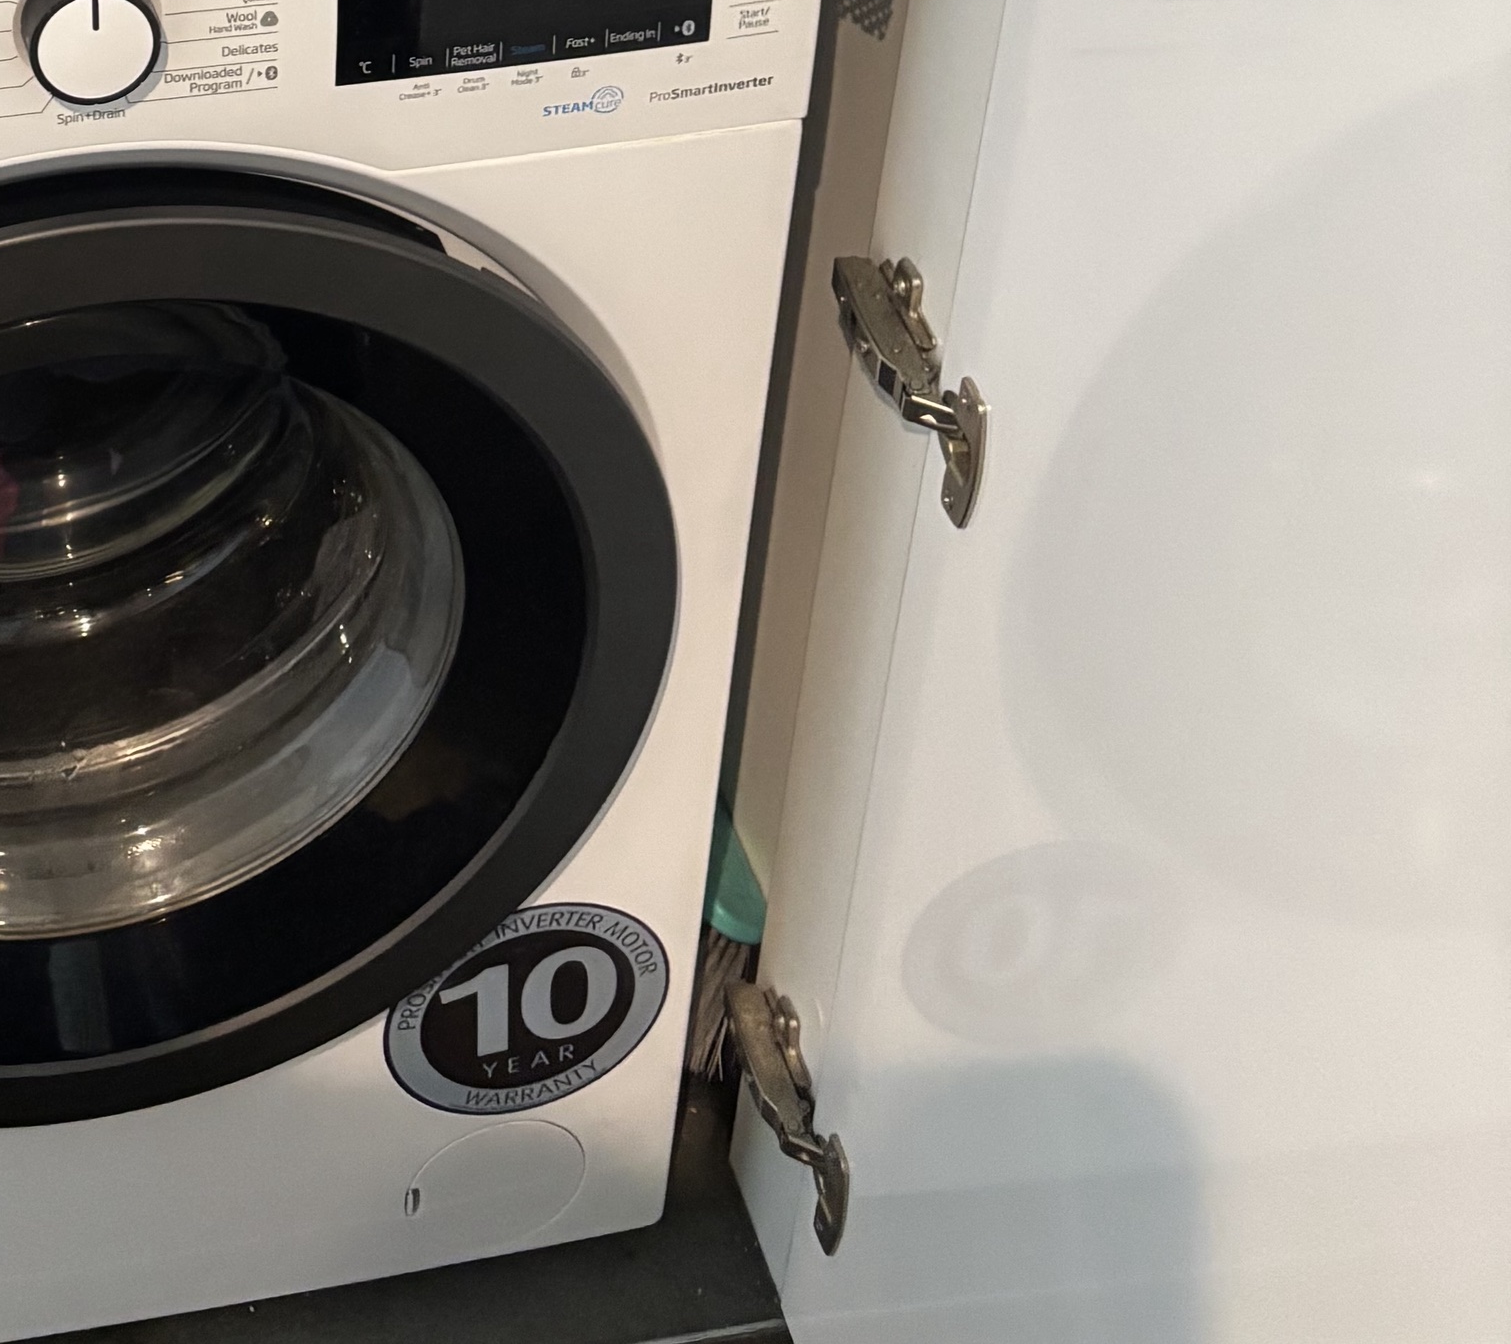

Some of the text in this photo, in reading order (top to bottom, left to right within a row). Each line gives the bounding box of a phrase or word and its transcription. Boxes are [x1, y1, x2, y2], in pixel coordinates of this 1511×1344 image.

[226, 10, 257, 24] Wool
[739, 17, 769, 29] Pause
[209, 22, 257, 34] Hand Wash
[610, 28, 656, 43] Ending In
[221, 43, 279, 57] Delicates
[453, 43, 496, 56] Pet Hair
[409, 56, 433, 68] Spin
[451, 53, 497, 67] Removal
[164, 66, 242, 83] Downloaded
[189, 79, 242, 93] Program
[649, 75, 774, 103] ProSmartInverter
[56, 108, 126, 126] Spin+Drain
[494, 910, 658, 977] INVERTER MOTOR
[439, 946, 617, 1057] 10
[483, 1043, 574, 1078] YEAR
[465, 1059, 598, 1106] WARRANTY
